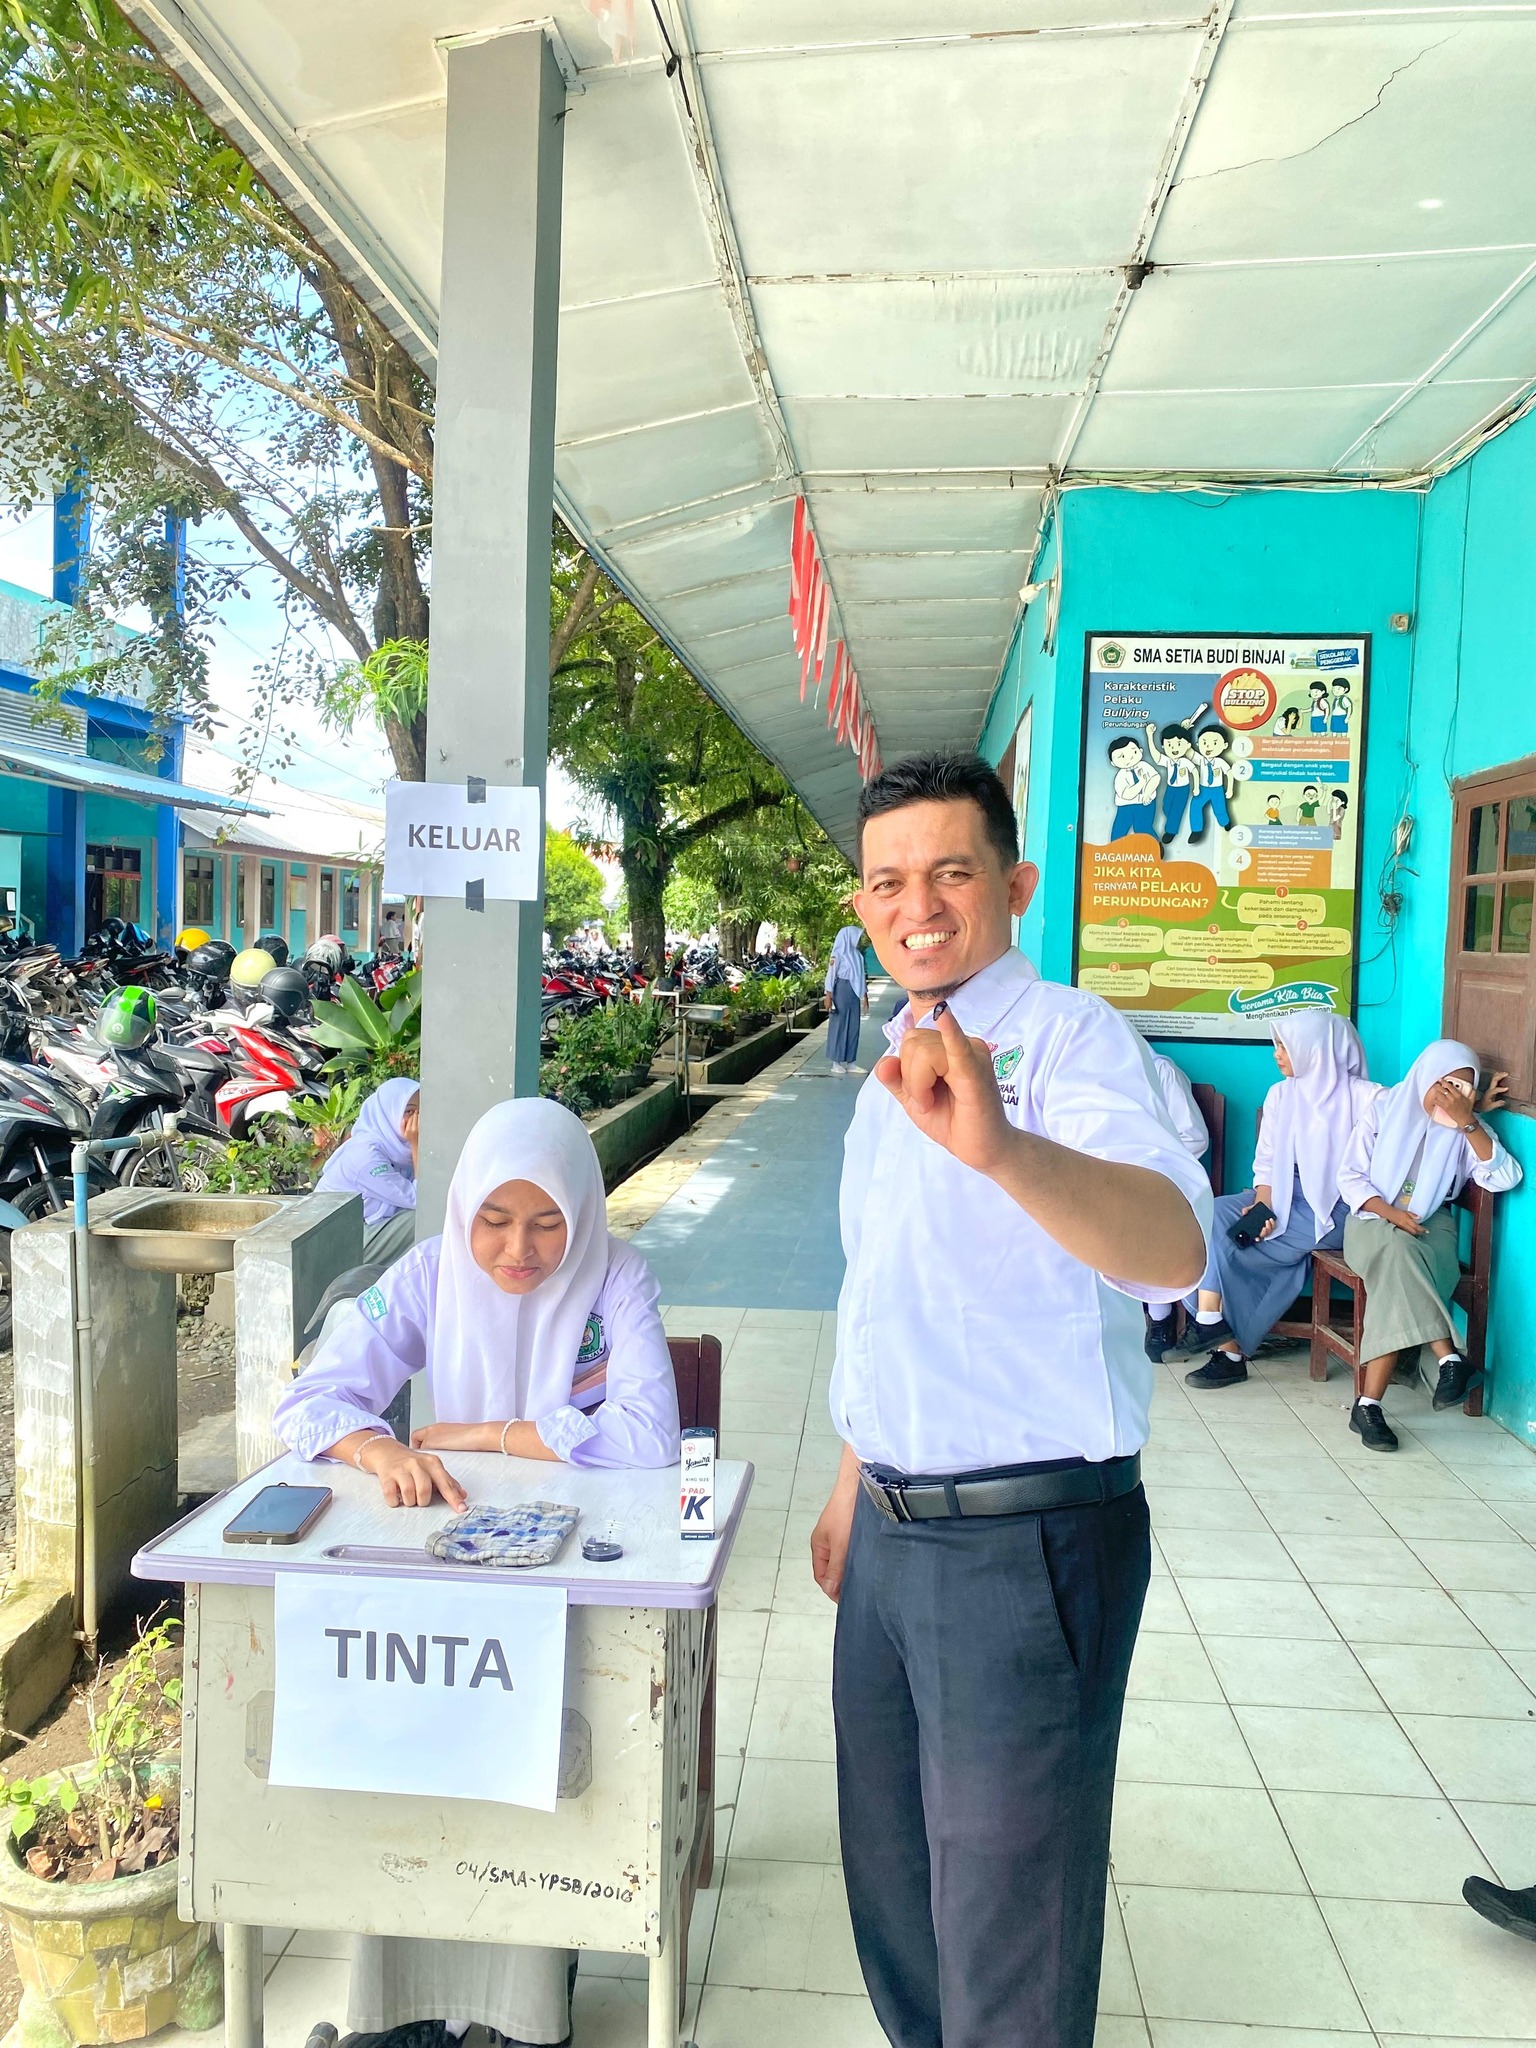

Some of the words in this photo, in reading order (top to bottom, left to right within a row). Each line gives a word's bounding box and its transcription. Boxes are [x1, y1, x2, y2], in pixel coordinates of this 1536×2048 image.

[1133, 648, 1162, 663] SMA
[1165, 648, 1203, 664] SETIA
[1207, 649, 1238, 664] BUDI
[1242, 649, 1285, 665] BINJAI
[1104, 681, 1176, 691] Karakteristik
[1104, 695, 1142, 704] Pelaku
[1228, 689, 1265, 699] STOP
[1103, 708, 1150, 719] Bullying
[1241, 743, 1245, 751] 1
[1240, 766, 1245, 774] 2
[408, 823, 521, 852] KELUAR
[1237, 832, 1243, 840] 3
[1094, 853, 1154, 862] BAGAIMANA
[1236, 856, 1243, 864] 4
[1093, 866, 1125, 877] JIKA
[1130, 867, 1162, 878] KITA
[1093, 882, 1138, 891] TERNYATA
[1140, 881, 1201, 893] PELAKU
[1093, 896, 1209, 908] PERUNDUNGAN?
[1241, 998, 1274, 1011] Bersama
[1274, 989, 1299, 1003] Kita
[1301, 987, 1324, 1000] Bisa
[1246, 1011, 1288, 1020] Menghentikan
[120, 1079, 147, 1092] HONDA
[20, 1098, 49, 1114] HONDA
[324, 1628, 514, 1691] TINTA
